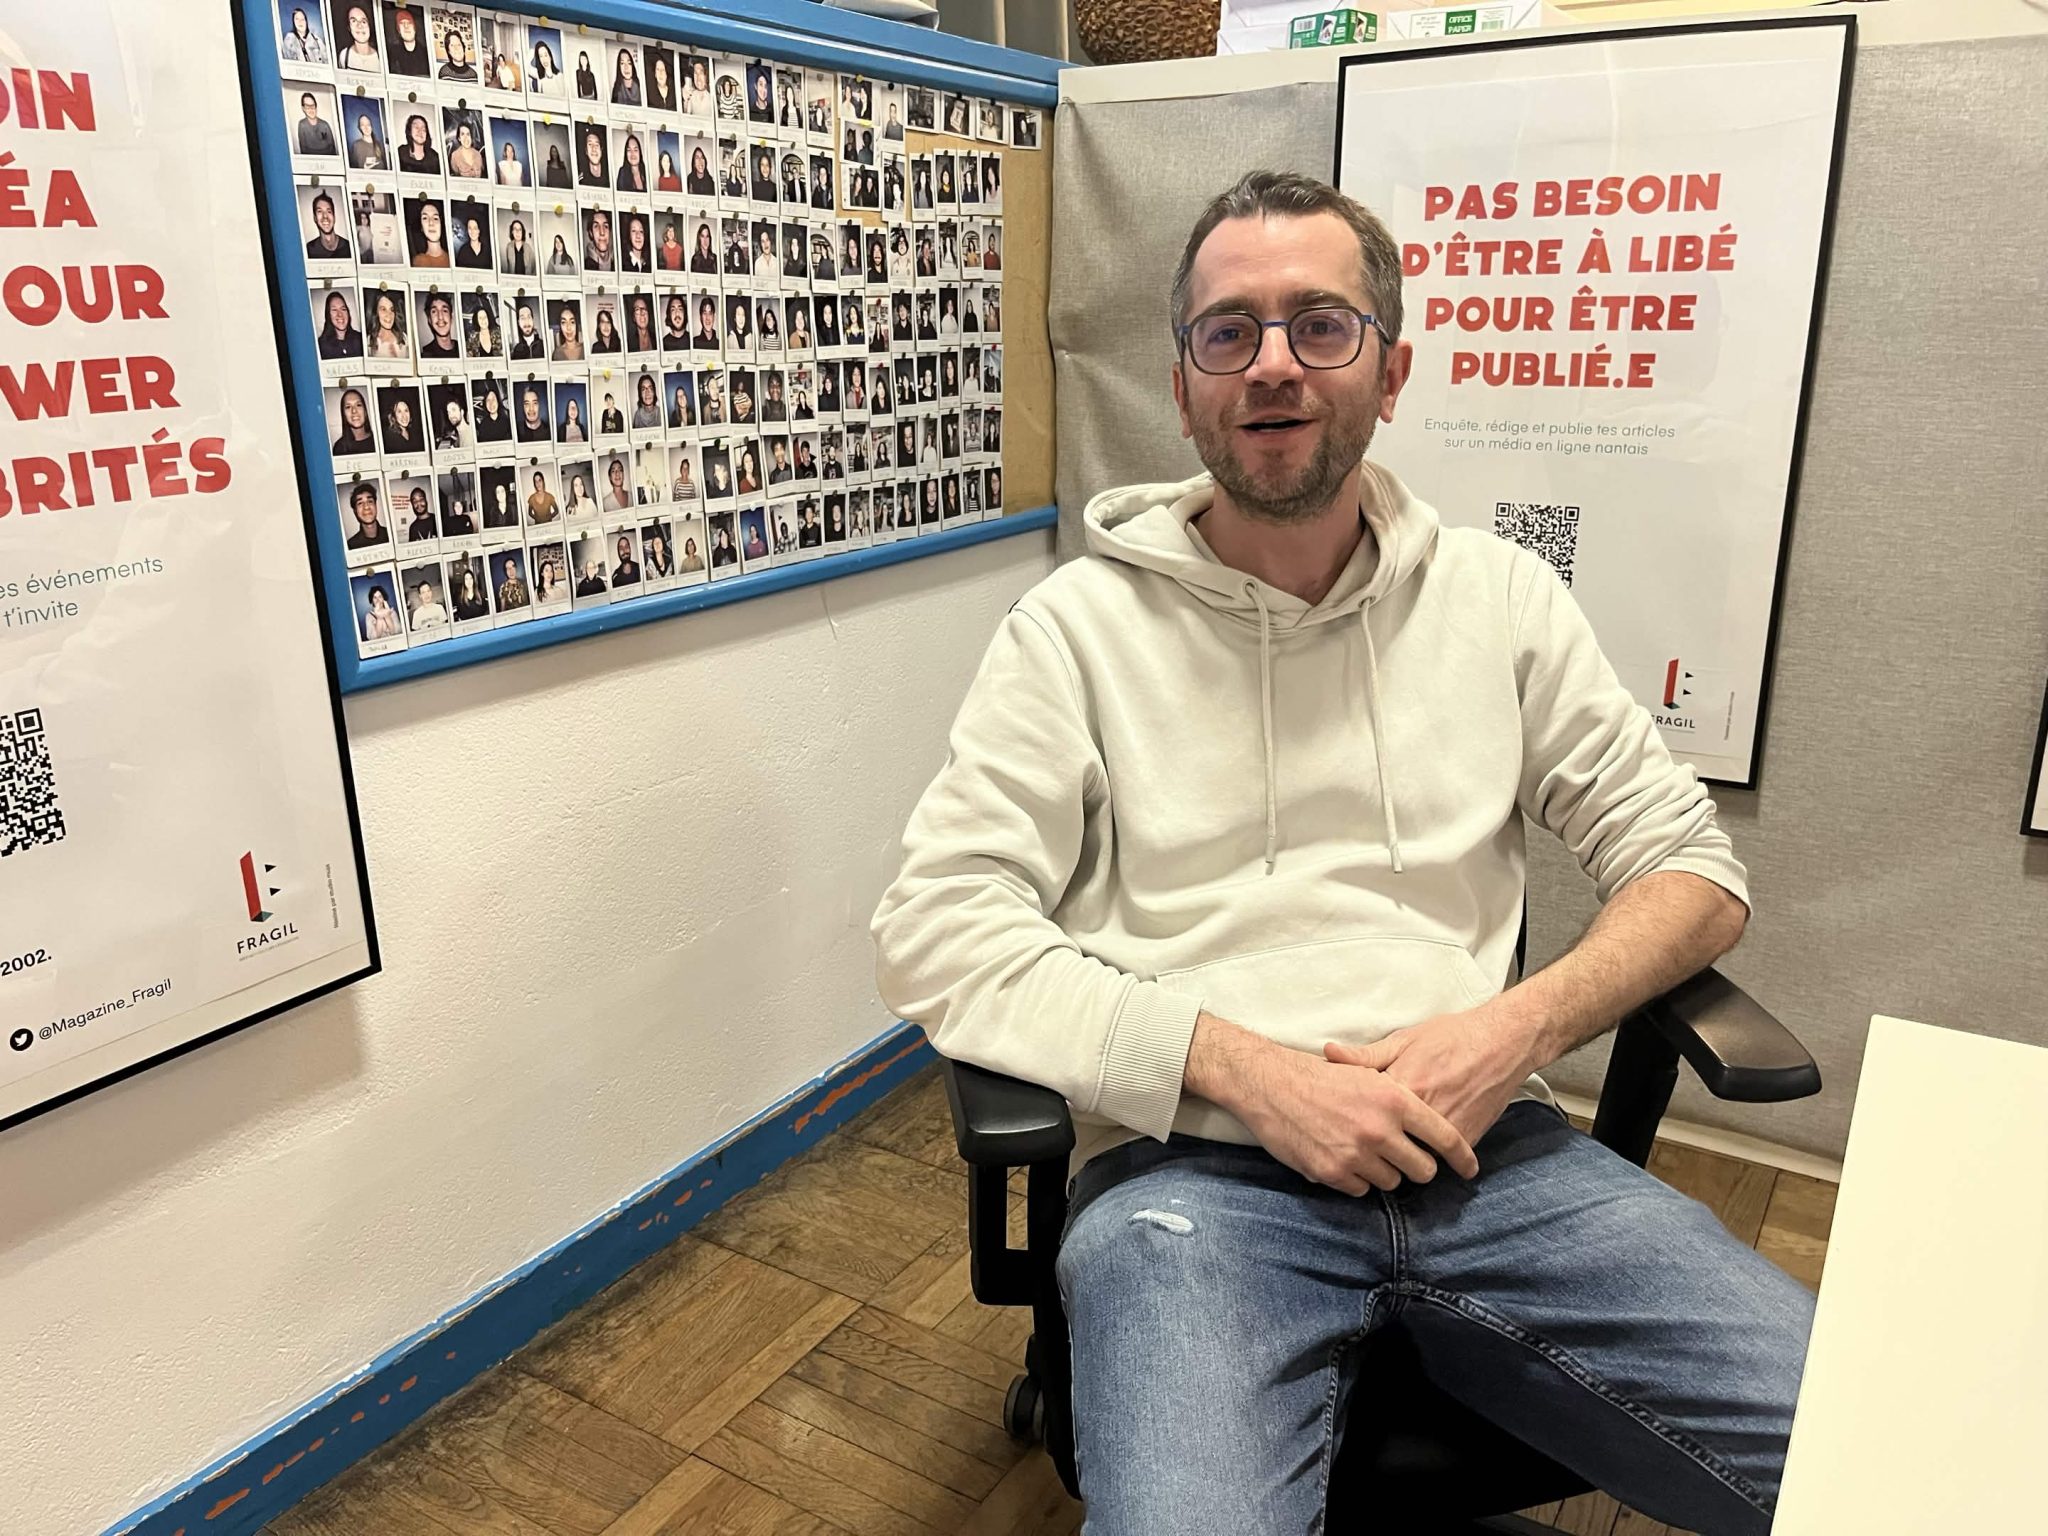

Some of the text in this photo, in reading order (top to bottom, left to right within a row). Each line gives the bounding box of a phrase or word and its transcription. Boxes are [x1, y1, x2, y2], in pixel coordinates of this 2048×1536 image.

[1447, 24, 1472, 34] PAPER
[0, 68, 96, 132] IN
[1424, 173, 1722, 221] PAS BESOIN
[1402, 223, 1738, 277] D'ÊTRE À LIBÉ
[1425, 285, 1697, 332] POUR ÊTRE
[1451, 343, 1656, 388] PUBLIÉ.E
[1424, 418, 1676, 438] Enquête, rédige et publie tes articles
[1444, 438, 1649, 455] sur un média en ligne nantais
[0, 427, 232, 519] RITÉS
[26, 557, 164, 594] événements
[3, 601, 79, 628] t'invite
[237, 922, 299, 954] FRAGIL
[0, 948, 52, 976] 2002.
[38, 977, 172, 1040] @Magazine_Fragil
